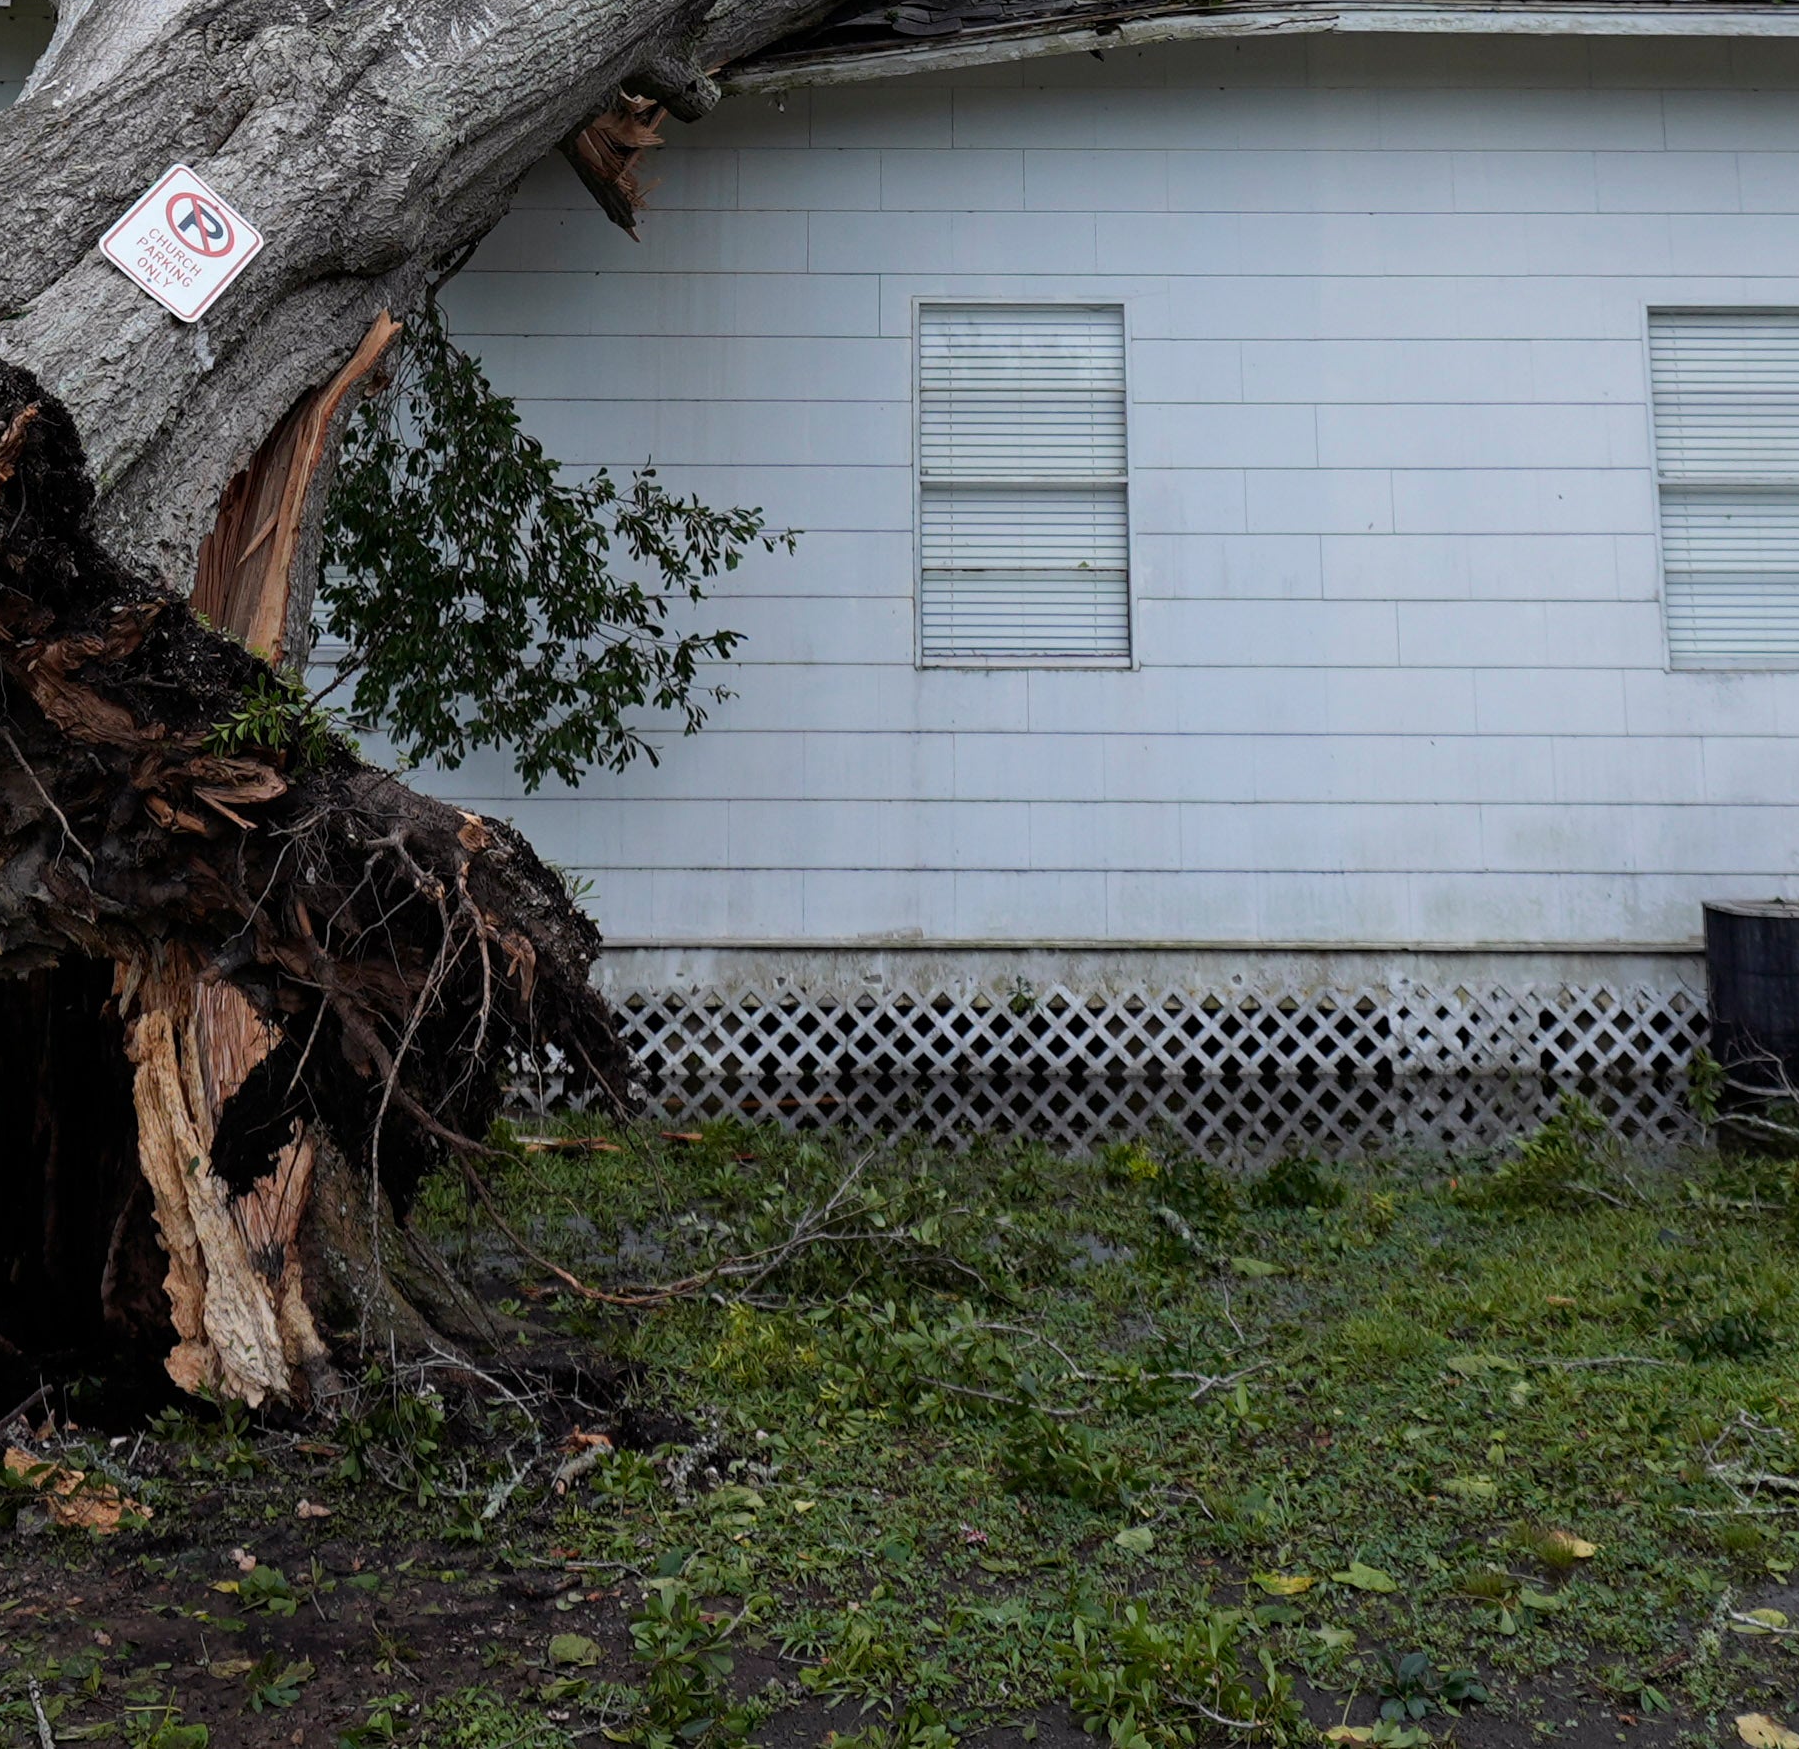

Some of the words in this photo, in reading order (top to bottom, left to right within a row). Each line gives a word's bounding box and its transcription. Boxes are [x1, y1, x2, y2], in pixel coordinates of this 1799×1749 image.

[178, 205, 223, 239] P
[136, 237, 193, 288] PARKING
[137, 257, 173, 288] ONLY
[149, 228, 202, 276] CHURCH
